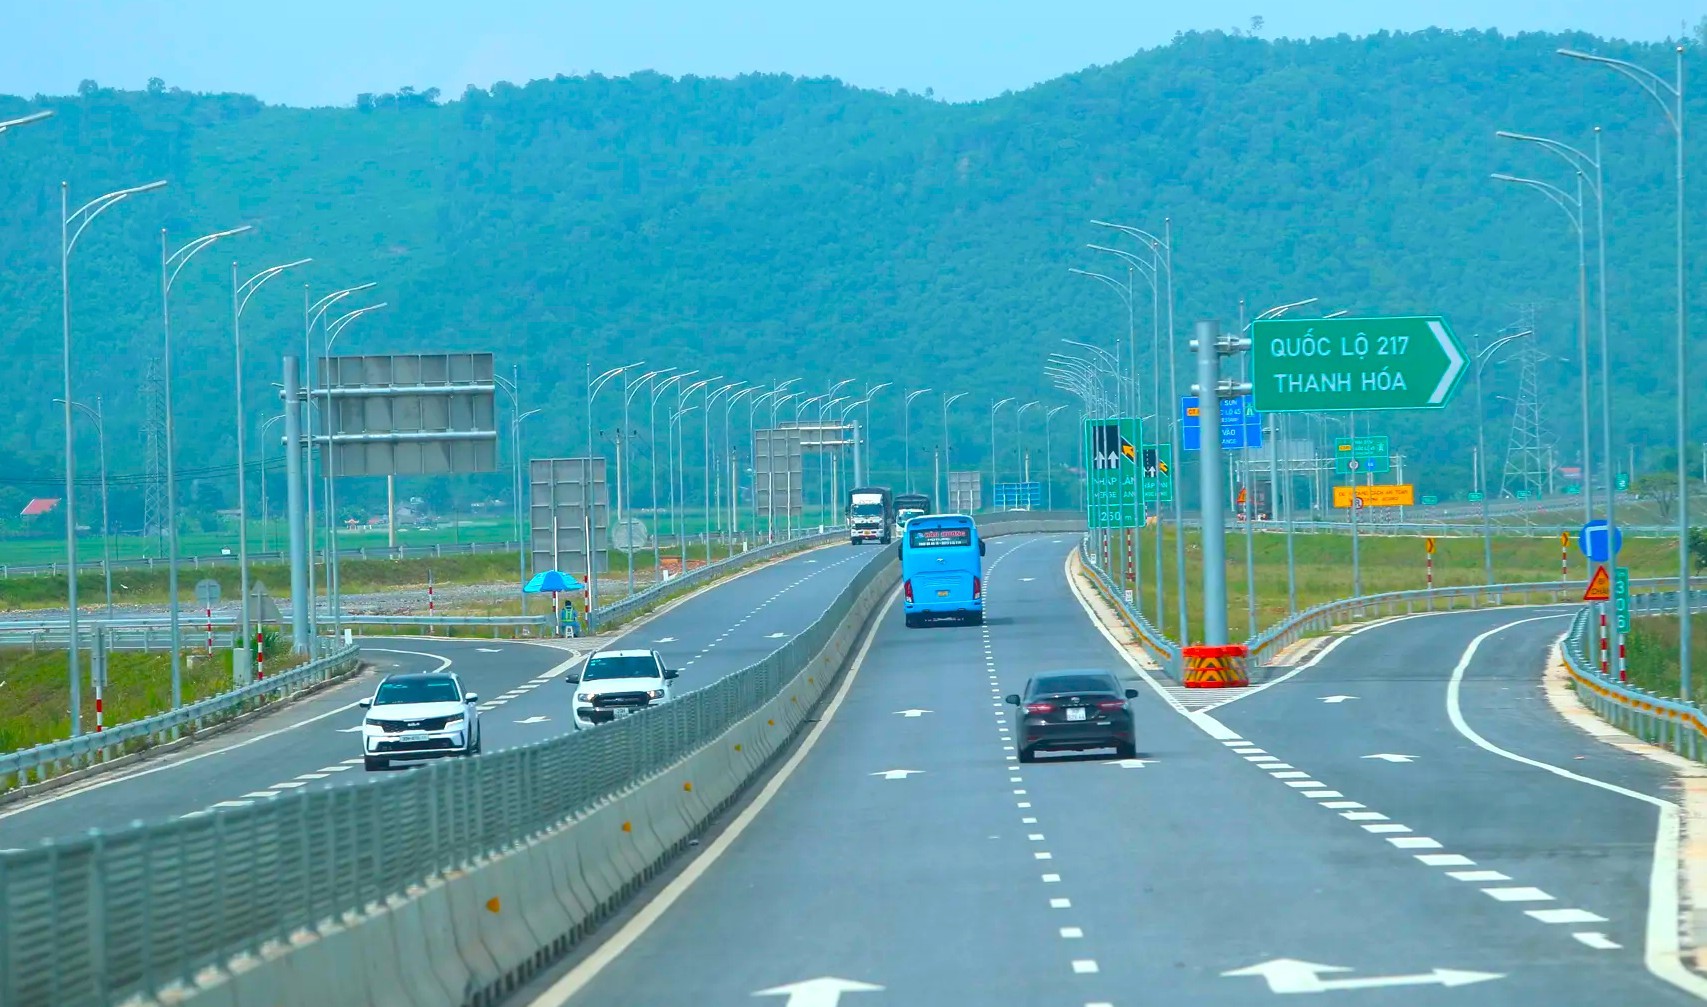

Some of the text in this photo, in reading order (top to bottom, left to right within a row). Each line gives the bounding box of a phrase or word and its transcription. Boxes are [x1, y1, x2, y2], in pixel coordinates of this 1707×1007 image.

[1270, 328, 1410, 359] QUỐC LỘ 217
[1273, 366, 1407, 393] THANH HÓA
